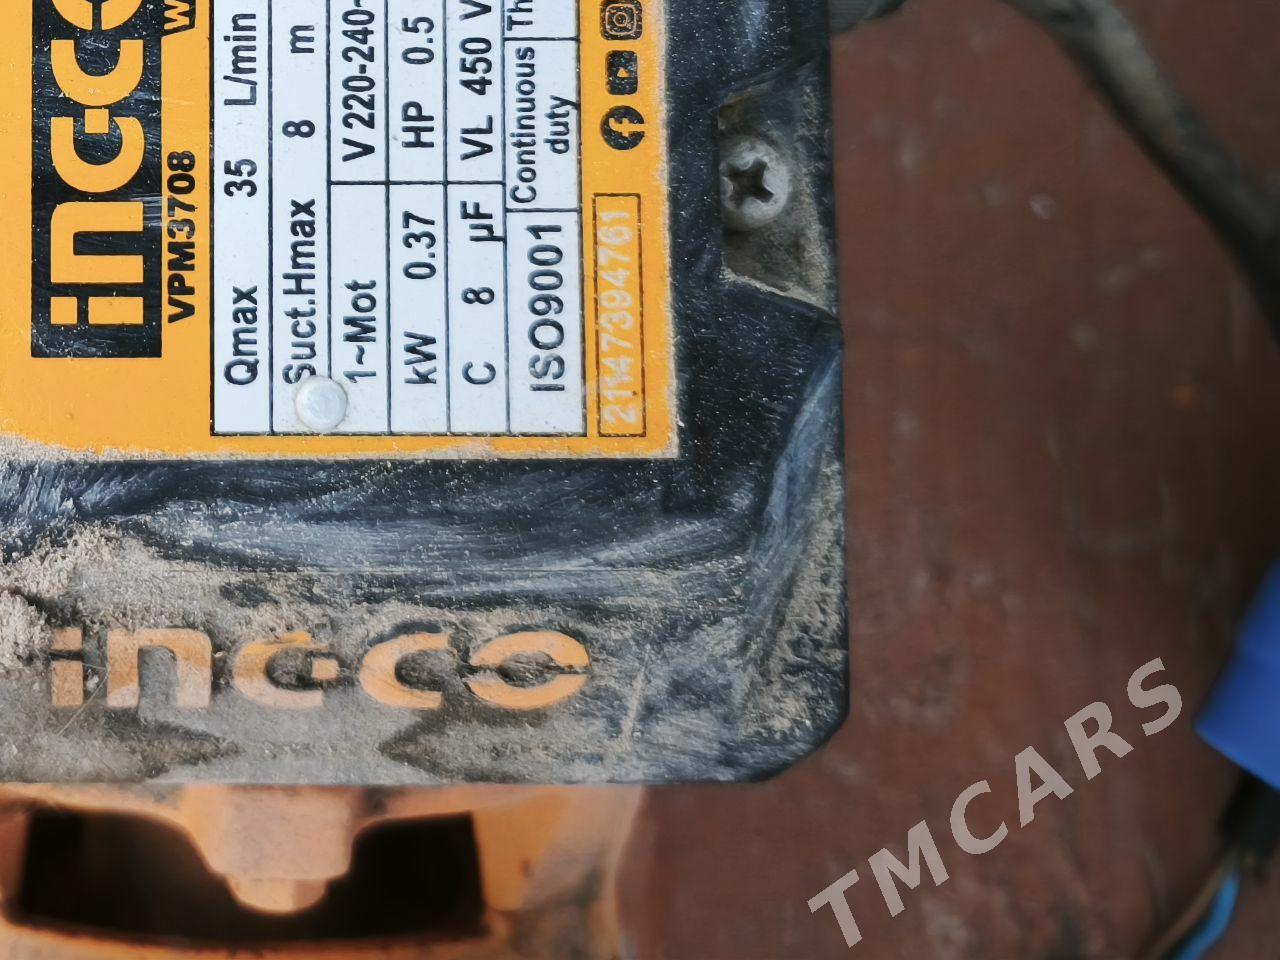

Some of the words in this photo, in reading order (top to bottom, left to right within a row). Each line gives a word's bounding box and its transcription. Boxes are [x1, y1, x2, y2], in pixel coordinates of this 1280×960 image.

[222, 13, 259, 107] L/min
[287, 24, 315, 55] m
[401, 16, 435, 66] 0.5
[458, 36, 493, 96] 450
[282, 119, 316, 140] 8
[401, 100, 435, 148] HP
[459, 115, 494, 160] VL
[507, 46, 537, 205] Continuous
[543, 95, 579, 154] duty
[223, 158, 259, 198] 35
[166, 150, 196, 324] VPM3708
[402, 210, 437, 280] 0.37
[282, 198, 318, 385] Suct.Hmax
[461, 287, 495, 305] 8
[526, 223, 566, 393] ISO9001
[223, 285, 261, 387] Qmax
[342, 279, 378, 383] 1~Mot
[403, 331, 437, 386] kW
[461, 361, 496, 386] C
